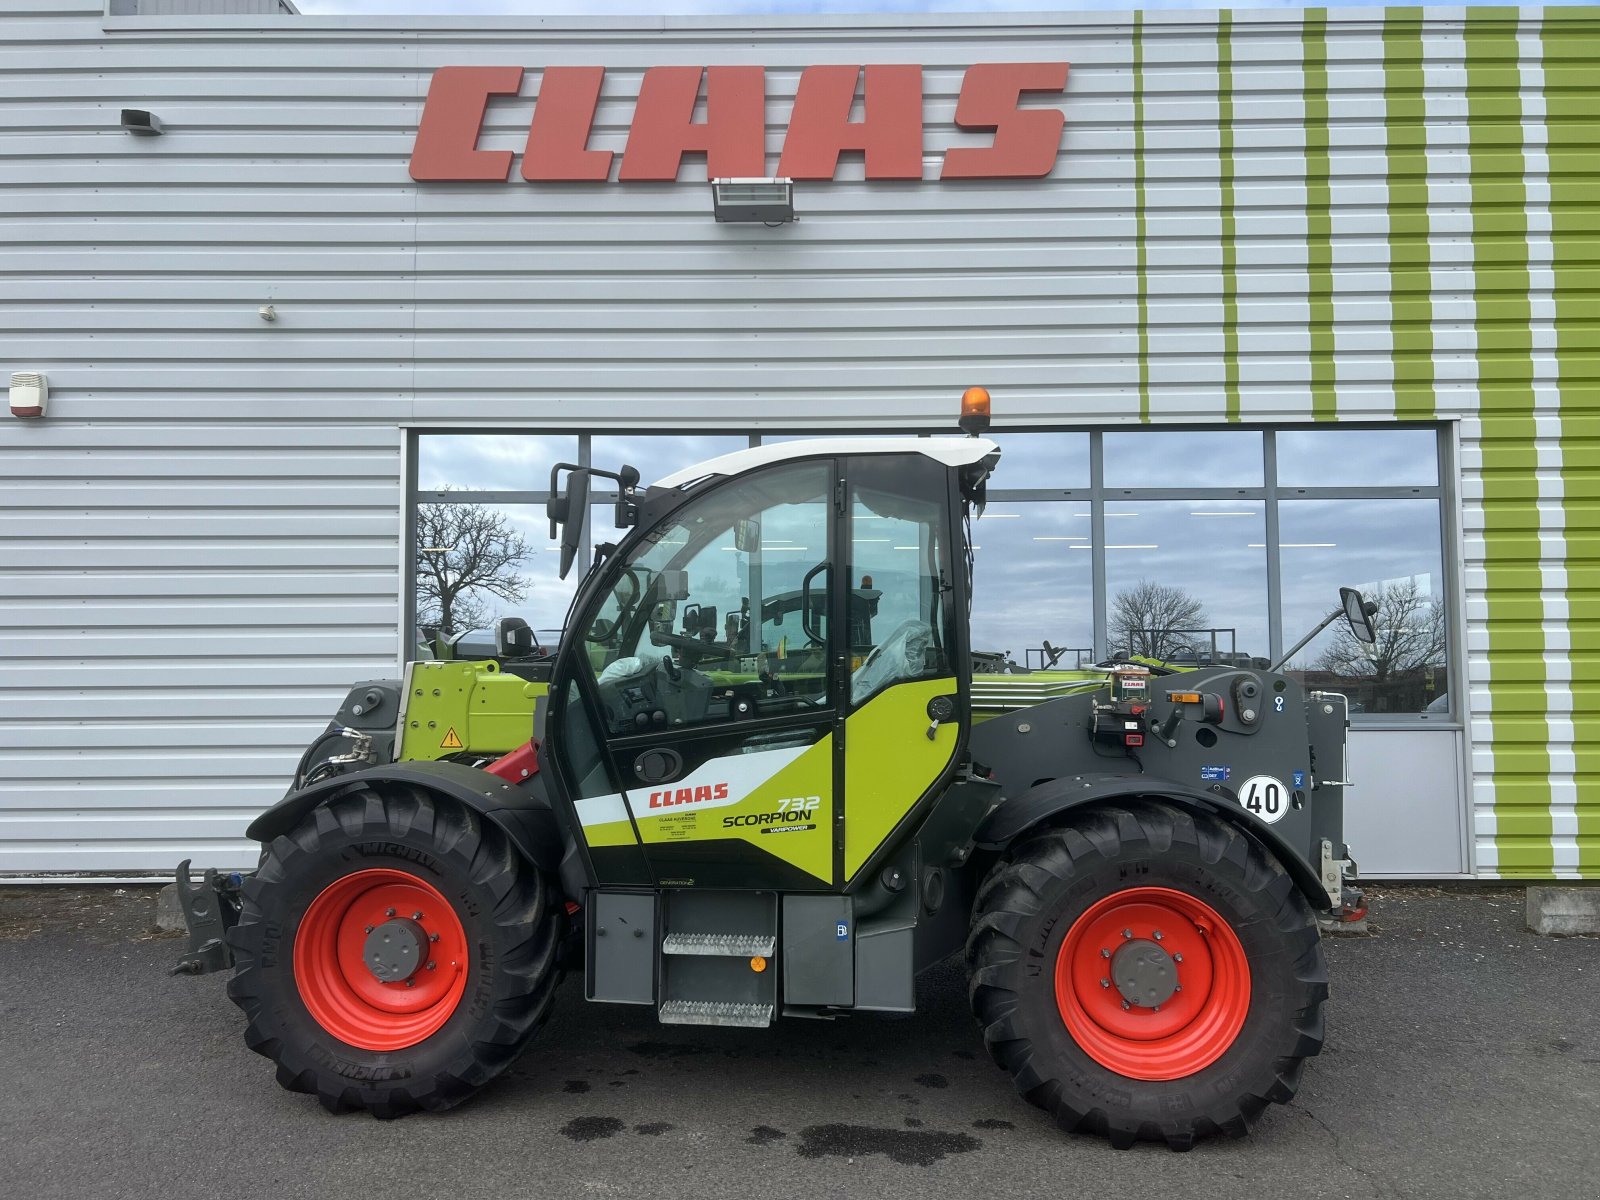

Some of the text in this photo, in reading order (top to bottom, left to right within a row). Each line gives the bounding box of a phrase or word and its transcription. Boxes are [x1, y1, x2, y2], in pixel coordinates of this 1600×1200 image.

[408, 62, 1070, 182] CLAAS
[649, 783, 728, 809] CLAAS
[778, 796, 820, 813] 732
[1246, 783, 1279, 814] 40
[722, 810, 812, 828] SCORPION
